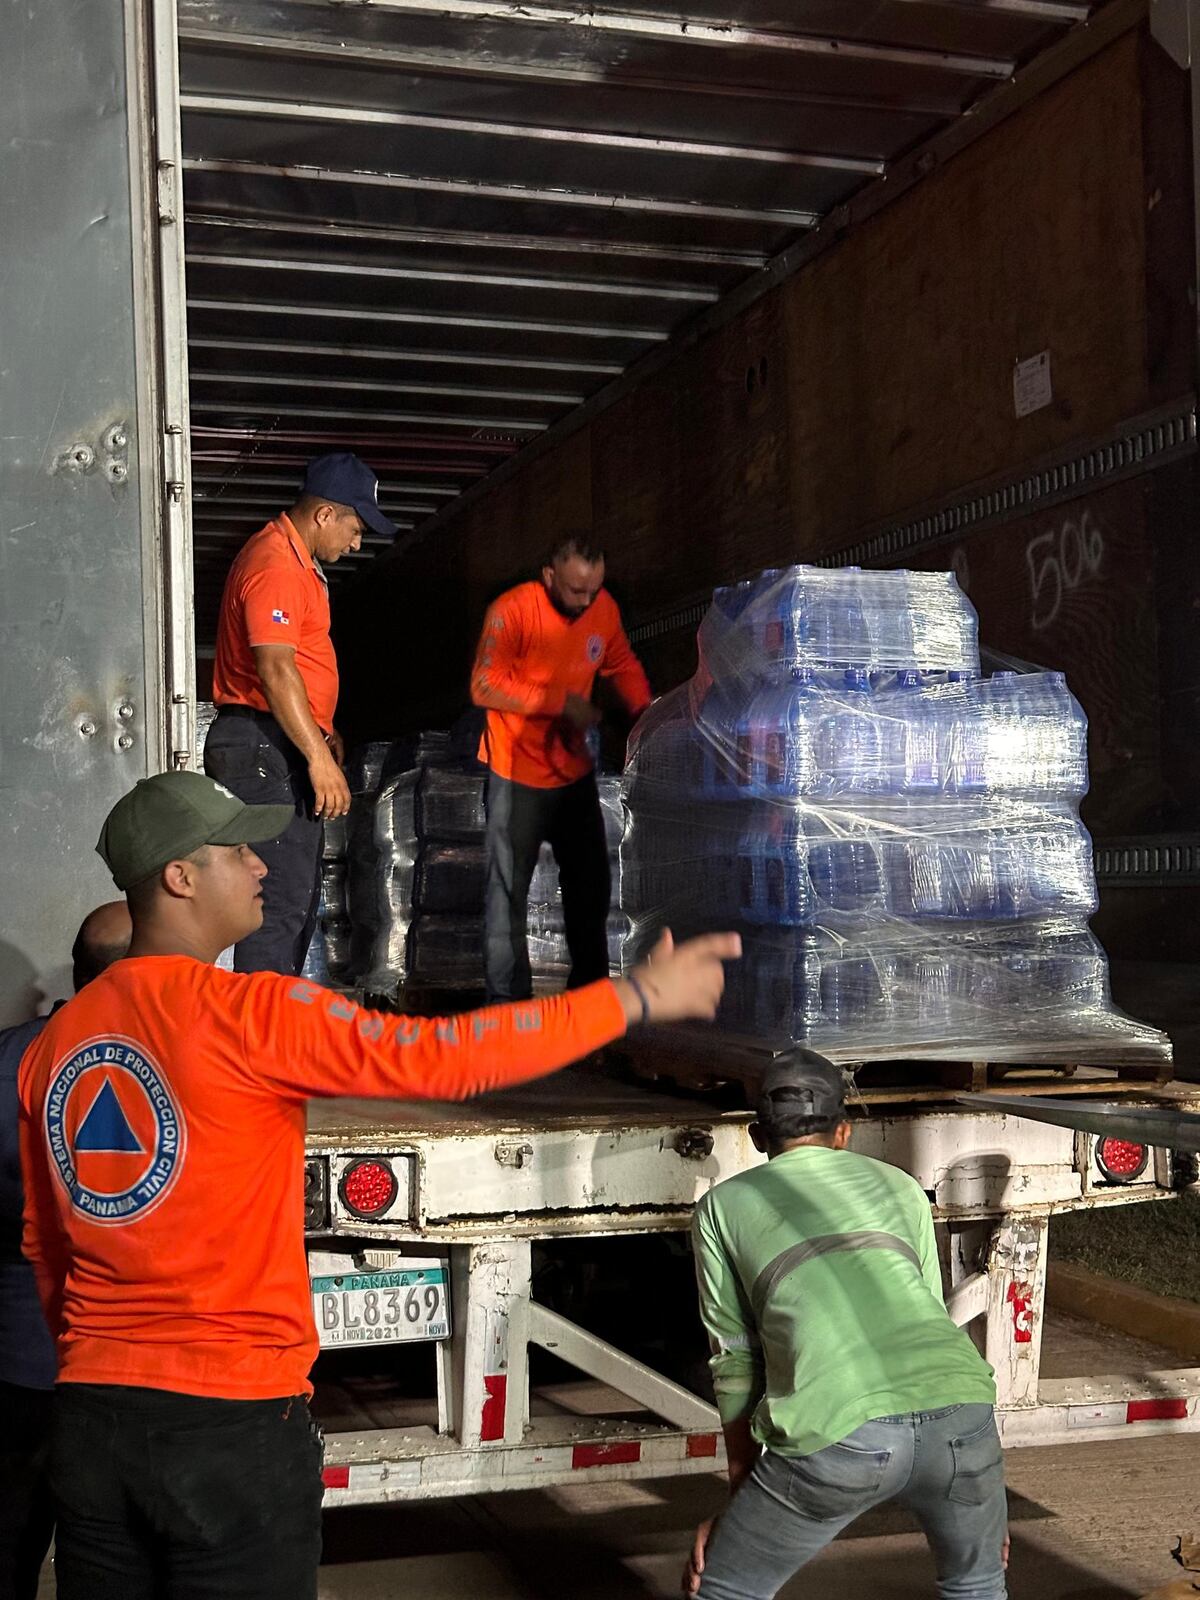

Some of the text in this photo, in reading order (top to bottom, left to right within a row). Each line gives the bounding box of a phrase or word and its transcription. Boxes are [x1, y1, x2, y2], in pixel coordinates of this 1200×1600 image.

[1026, 510, 1104, 629] 506
[50, 1047, 176, 1199] ISTEMA NACIONAL DE PROTECCION CIVIL
[80, 1193, 138, 1215] PANAMA
[352, 1274, 410, 1290] PANAMA
[322, 1285, 440, 1330] BL8369
